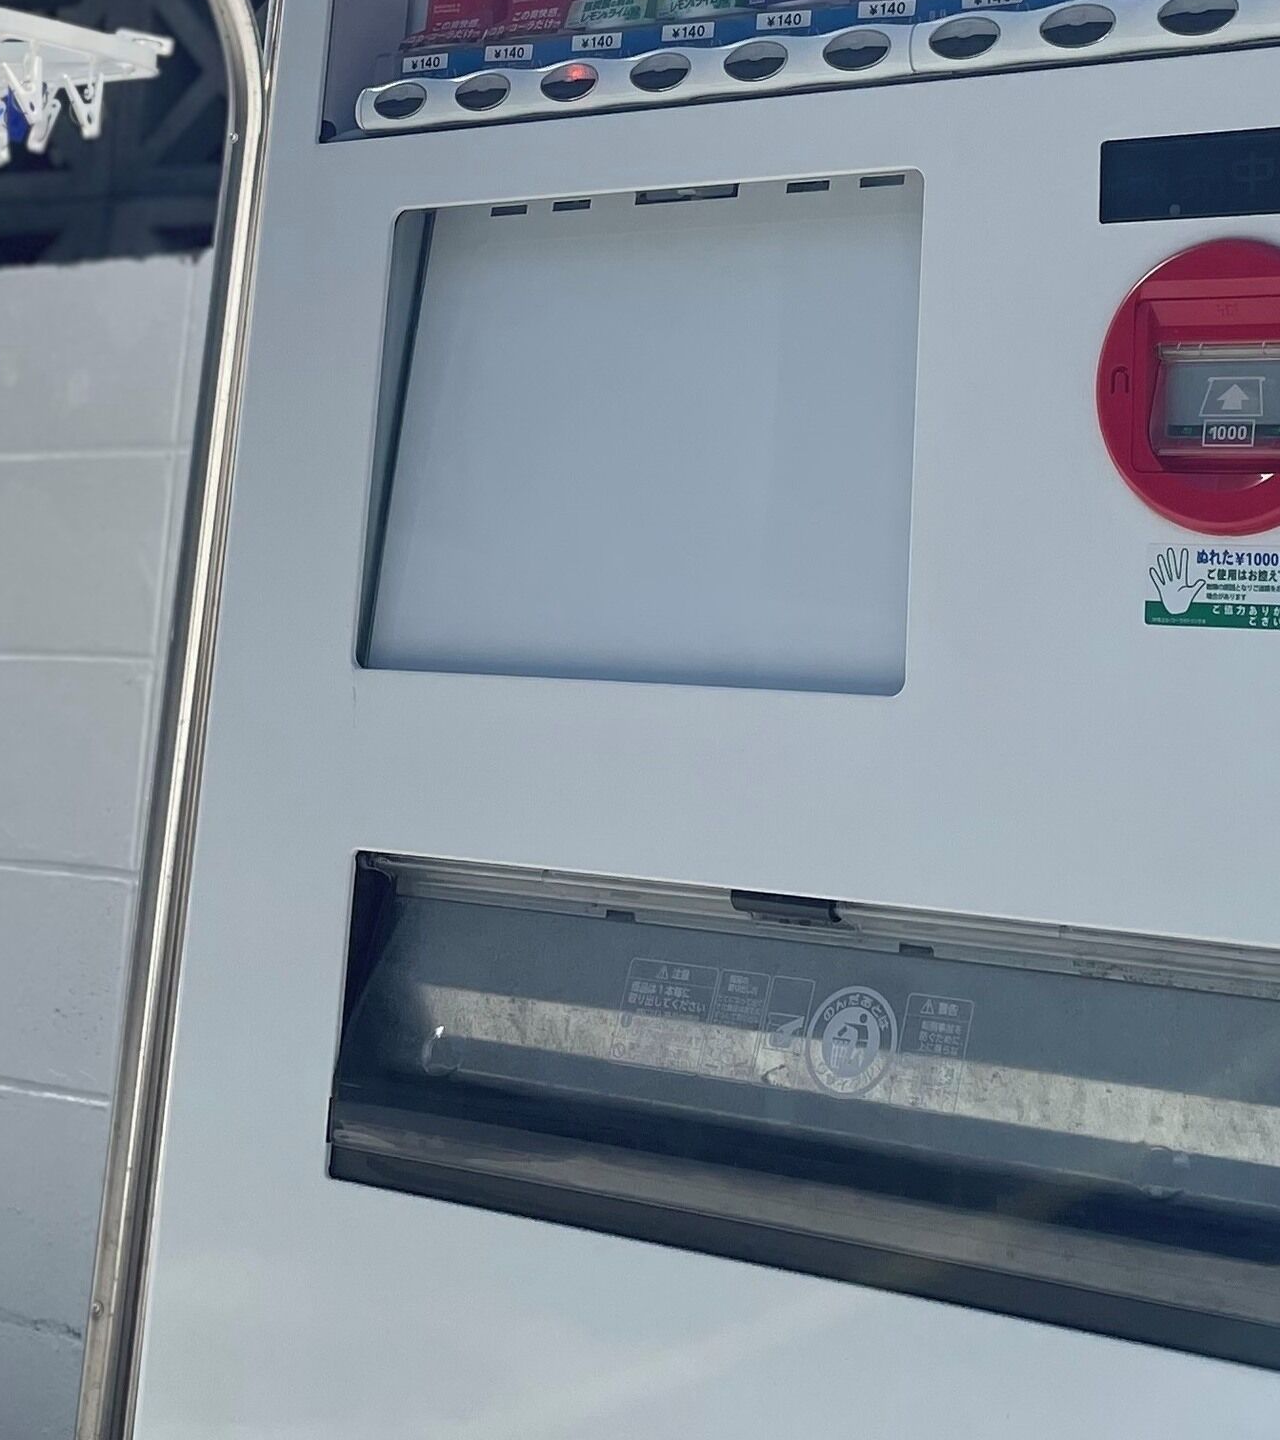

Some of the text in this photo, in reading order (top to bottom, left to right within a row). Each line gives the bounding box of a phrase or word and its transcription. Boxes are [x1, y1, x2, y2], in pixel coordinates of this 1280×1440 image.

[870, 2, 905, 15] ¥140
[768, 14, 801, 27] ¥140
[672, 25, 705, 38] ¥140
[582, 36, 613, 48] ¥140
[495, 47, 524, 58] ¥140
[412, 57, 440, 69] ¥140
[1209, 425, 1248, 441] 1000
